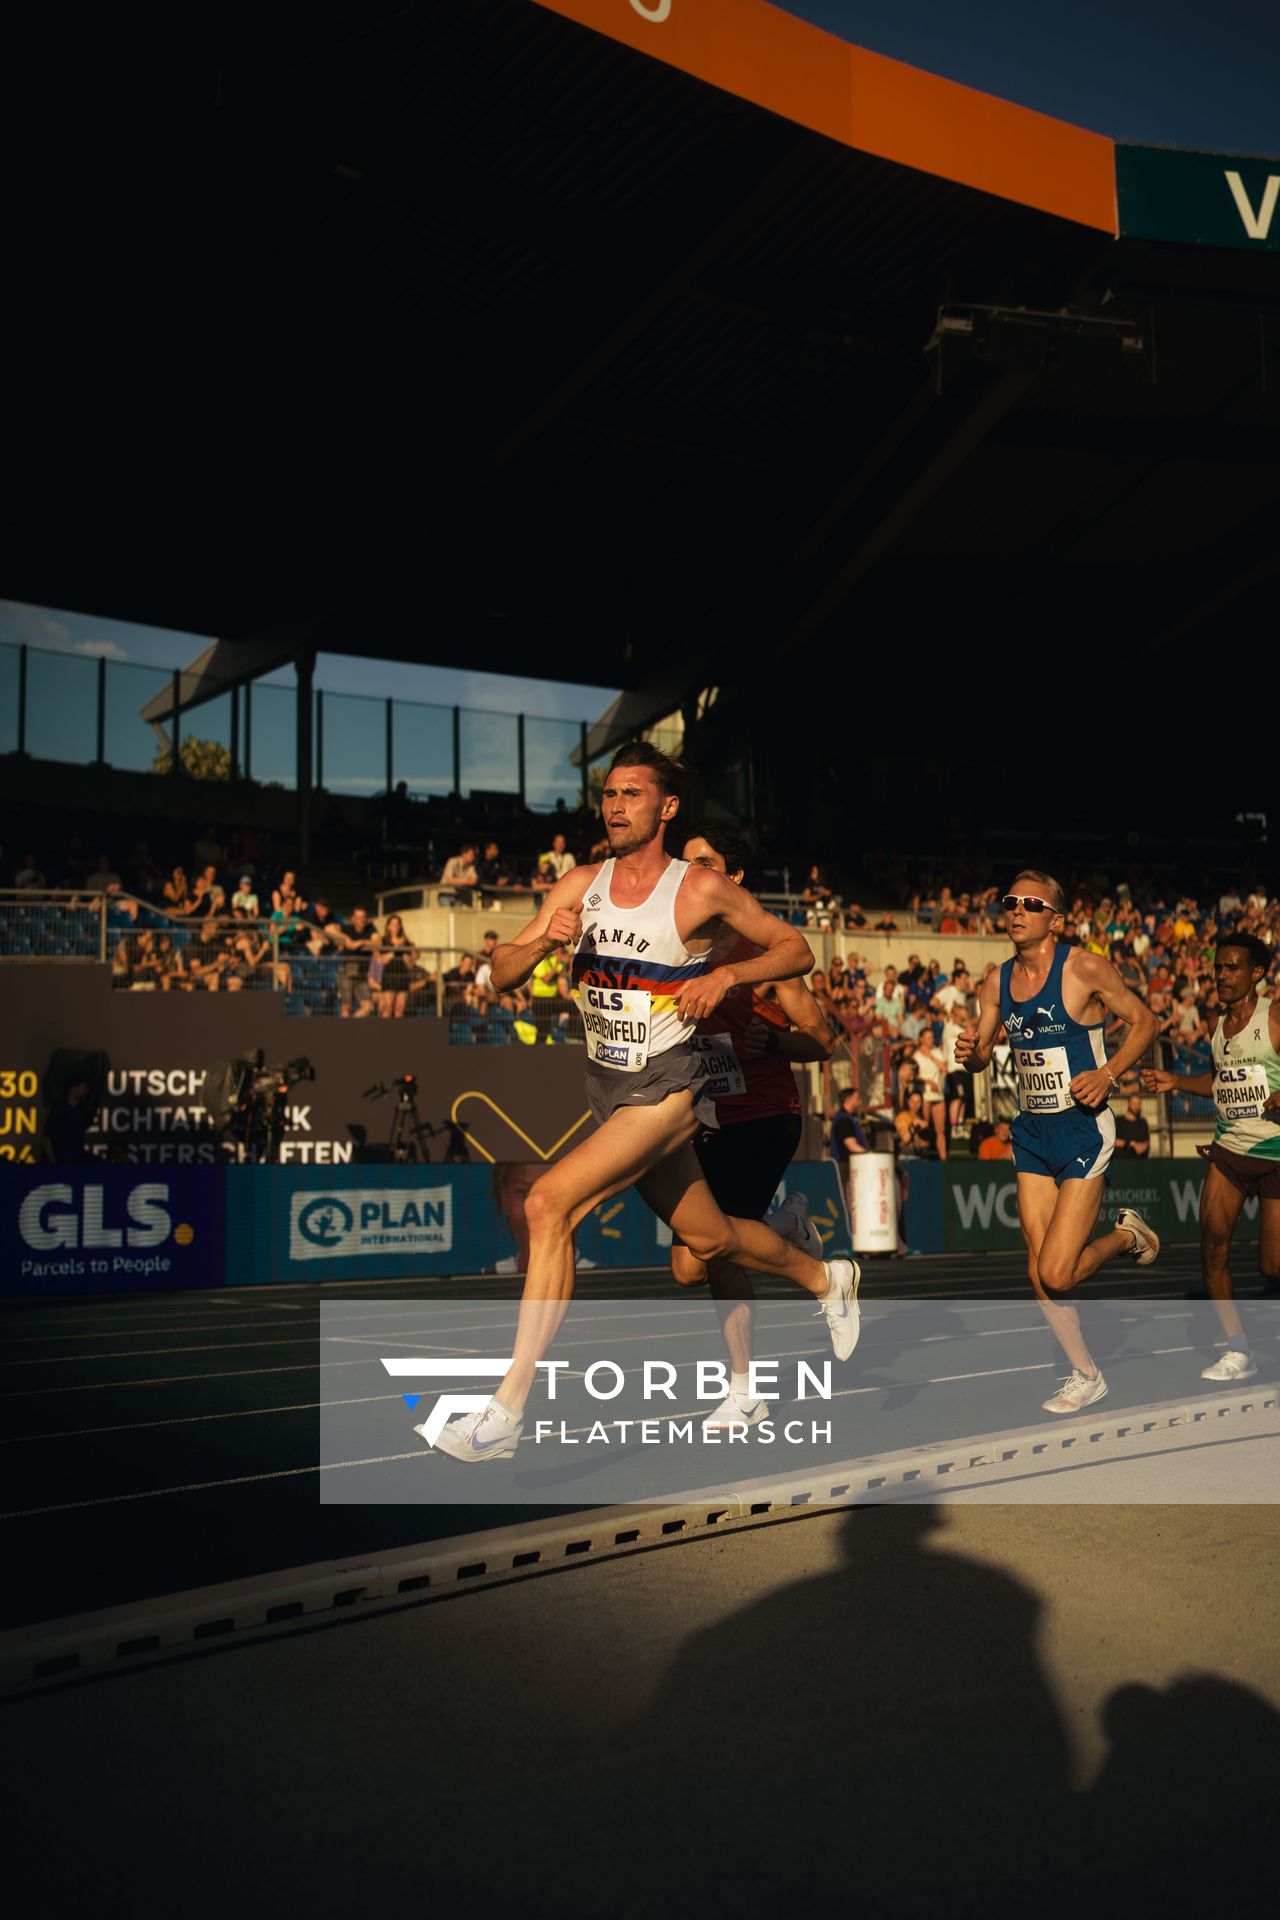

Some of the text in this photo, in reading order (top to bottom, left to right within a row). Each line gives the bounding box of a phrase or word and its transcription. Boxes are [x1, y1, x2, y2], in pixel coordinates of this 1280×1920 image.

[587, 928, 650, 953] HANAU
[1037, 1023, 1066, 1033] VIACTIV
[604, 1046, 627, 1061] PLAN
[0, 1069, 38, 1098] 30
[1036, 1096, 1057, 1105] PLAN
[1216, 1084, 1267, 1104] ABRAHAM
[1237, 1105, 1257, 1114] PLAN
[360, 1200, 445, 1229] PLAN
[360, 1234, 445, 1245] INTERNATIONAL
[21, 1254, 172, 1277] Parcels to People
